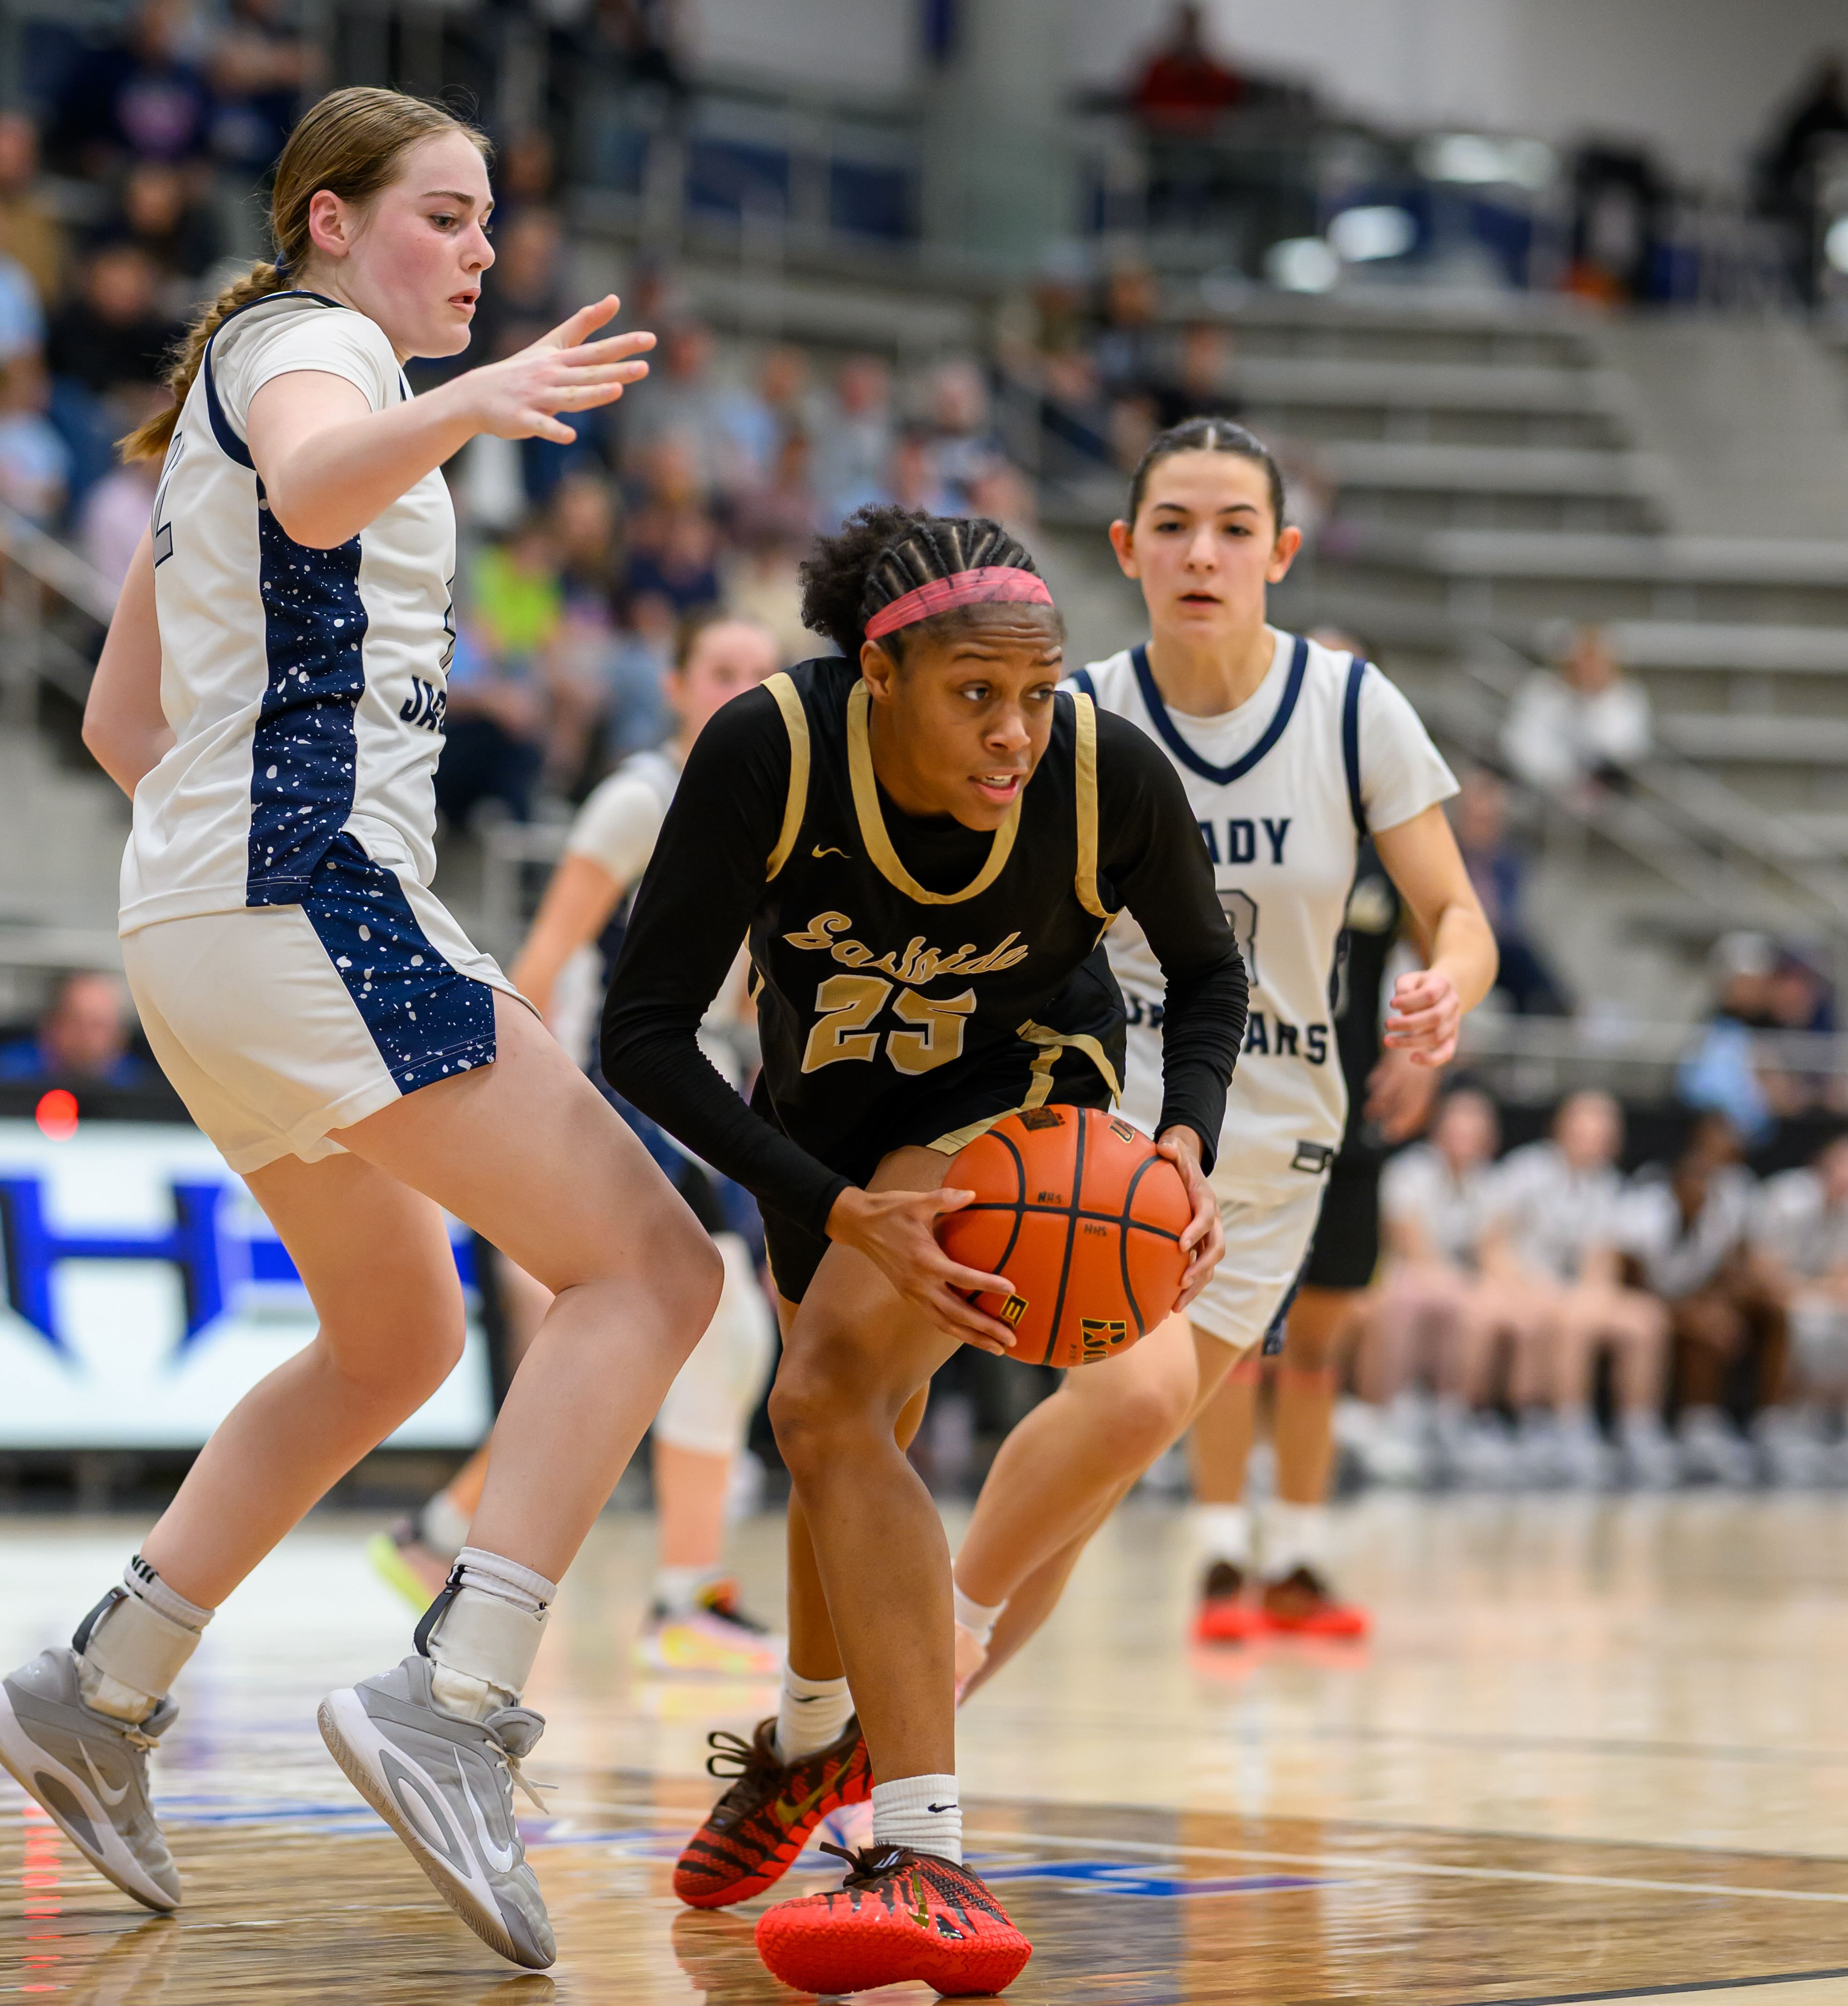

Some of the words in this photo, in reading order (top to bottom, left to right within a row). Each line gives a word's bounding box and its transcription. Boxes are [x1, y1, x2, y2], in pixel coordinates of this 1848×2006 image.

[1198, 817, 1293, 864] ADY
[801, 974, 977, 1075] 25
[1037, 1191, 1062, 1204] NHS
[1084, 1223, 1107, 1236] NHS
